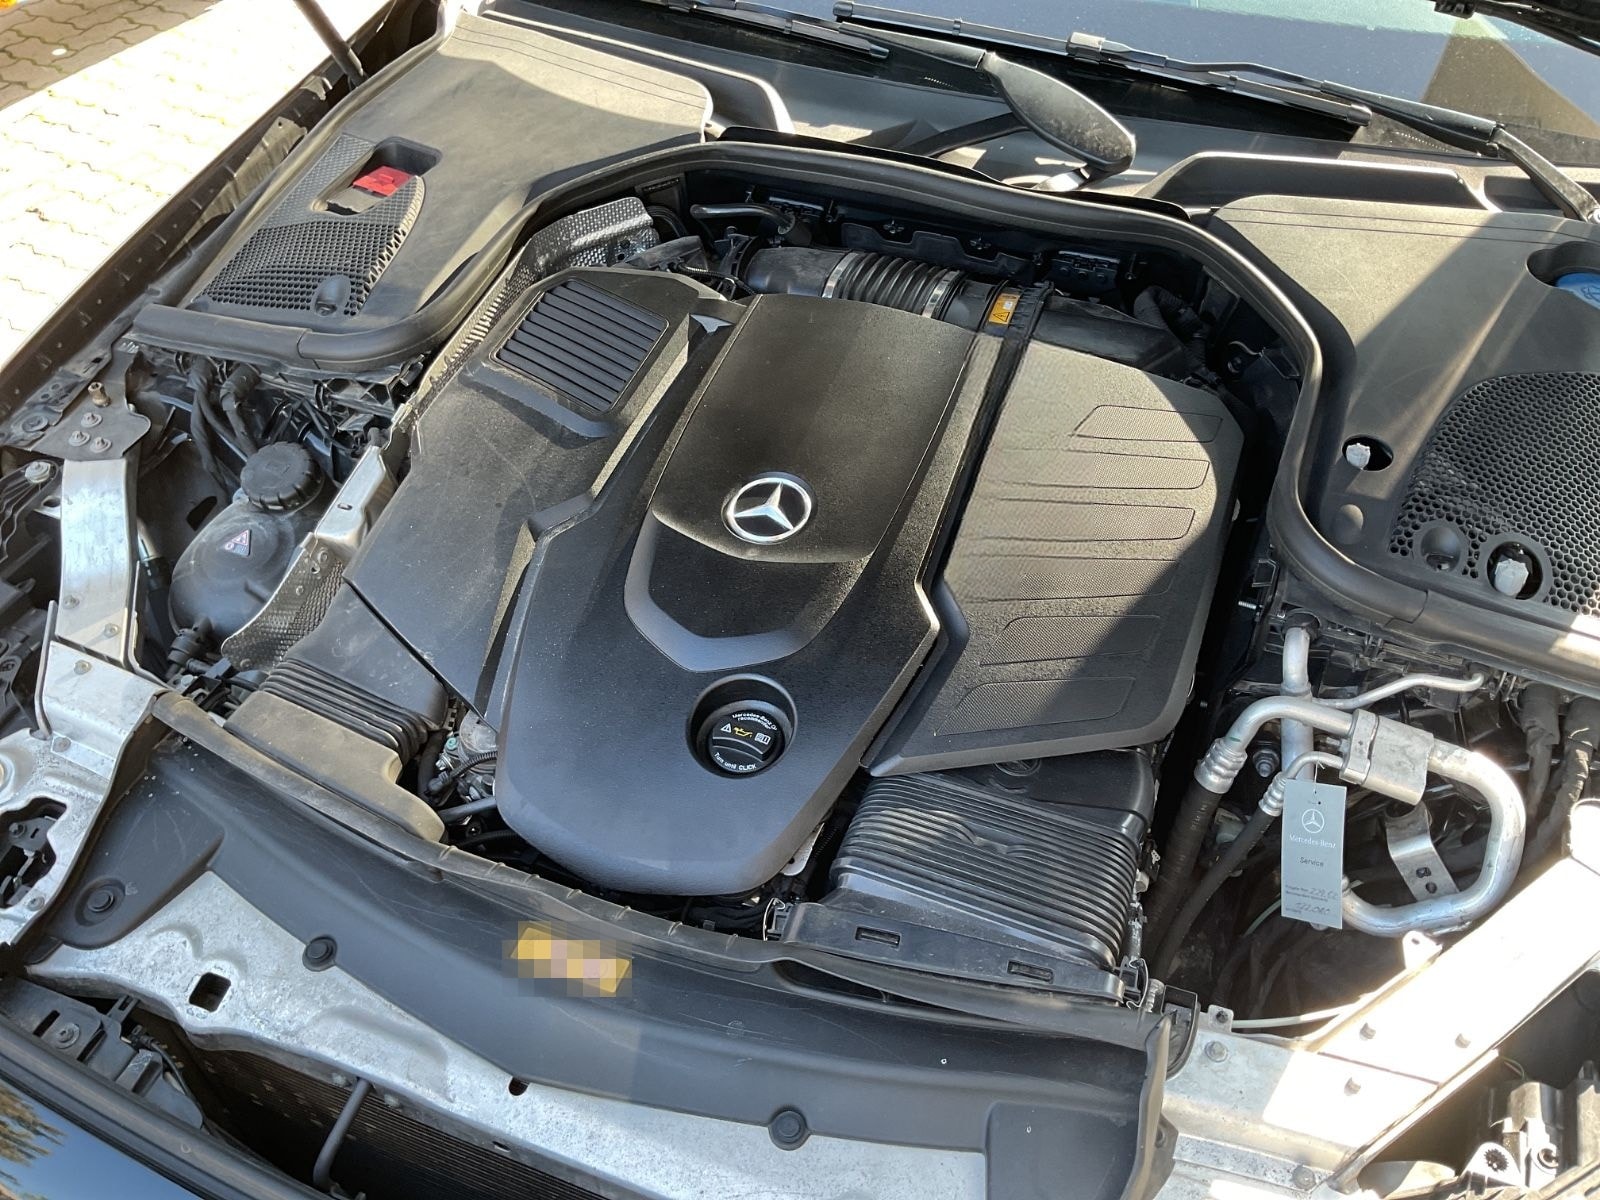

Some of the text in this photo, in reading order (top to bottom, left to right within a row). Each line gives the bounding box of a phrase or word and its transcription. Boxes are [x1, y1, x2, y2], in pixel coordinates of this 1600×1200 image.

[714, 751, 757, 771] Turn until CLICK
[1289, 833, 1337, 849] Mercedes-Benz
[1299, 856, 1324, 867] Service
